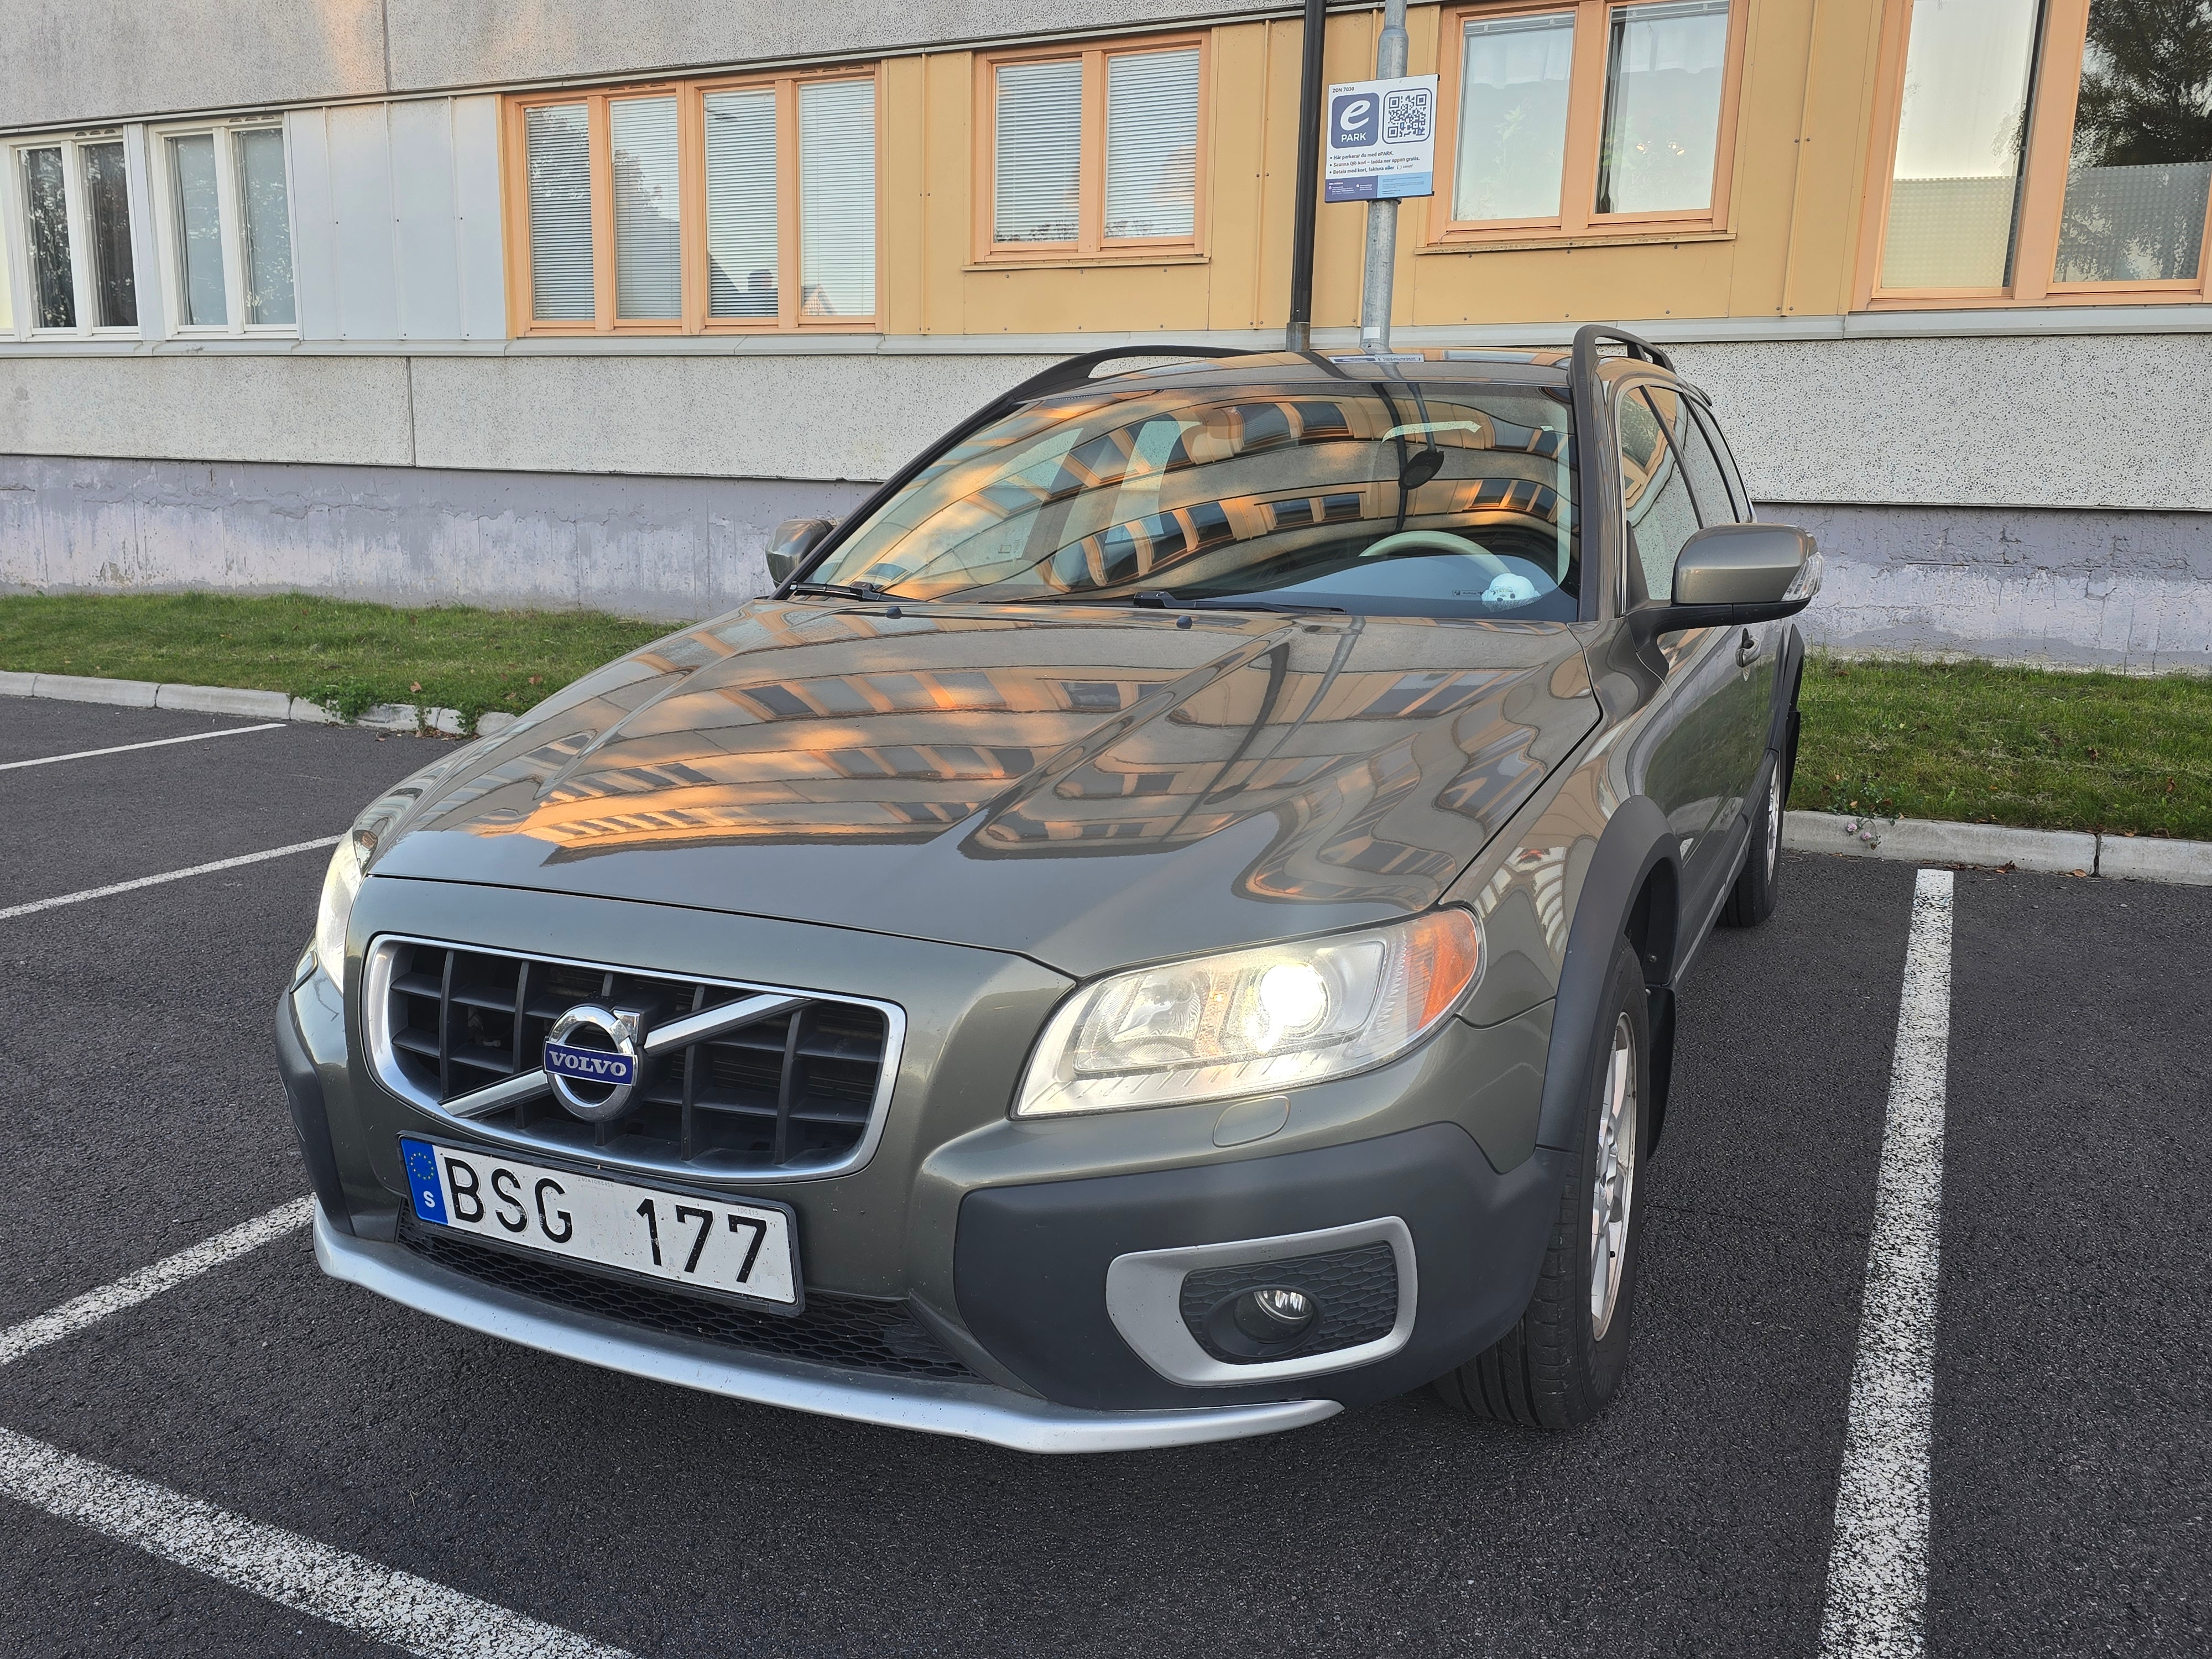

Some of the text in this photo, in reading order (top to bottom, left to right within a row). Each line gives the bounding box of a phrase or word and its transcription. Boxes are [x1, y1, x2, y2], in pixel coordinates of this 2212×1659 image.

[1340, 100, 1371, 131] e
[1341, 132, 1366, 142] PARK
[549, 1050, 627, 1077] VOLVO
[423, 1190, 435, 1209] S
[444, 1156, 768, 1285] BSG 177
